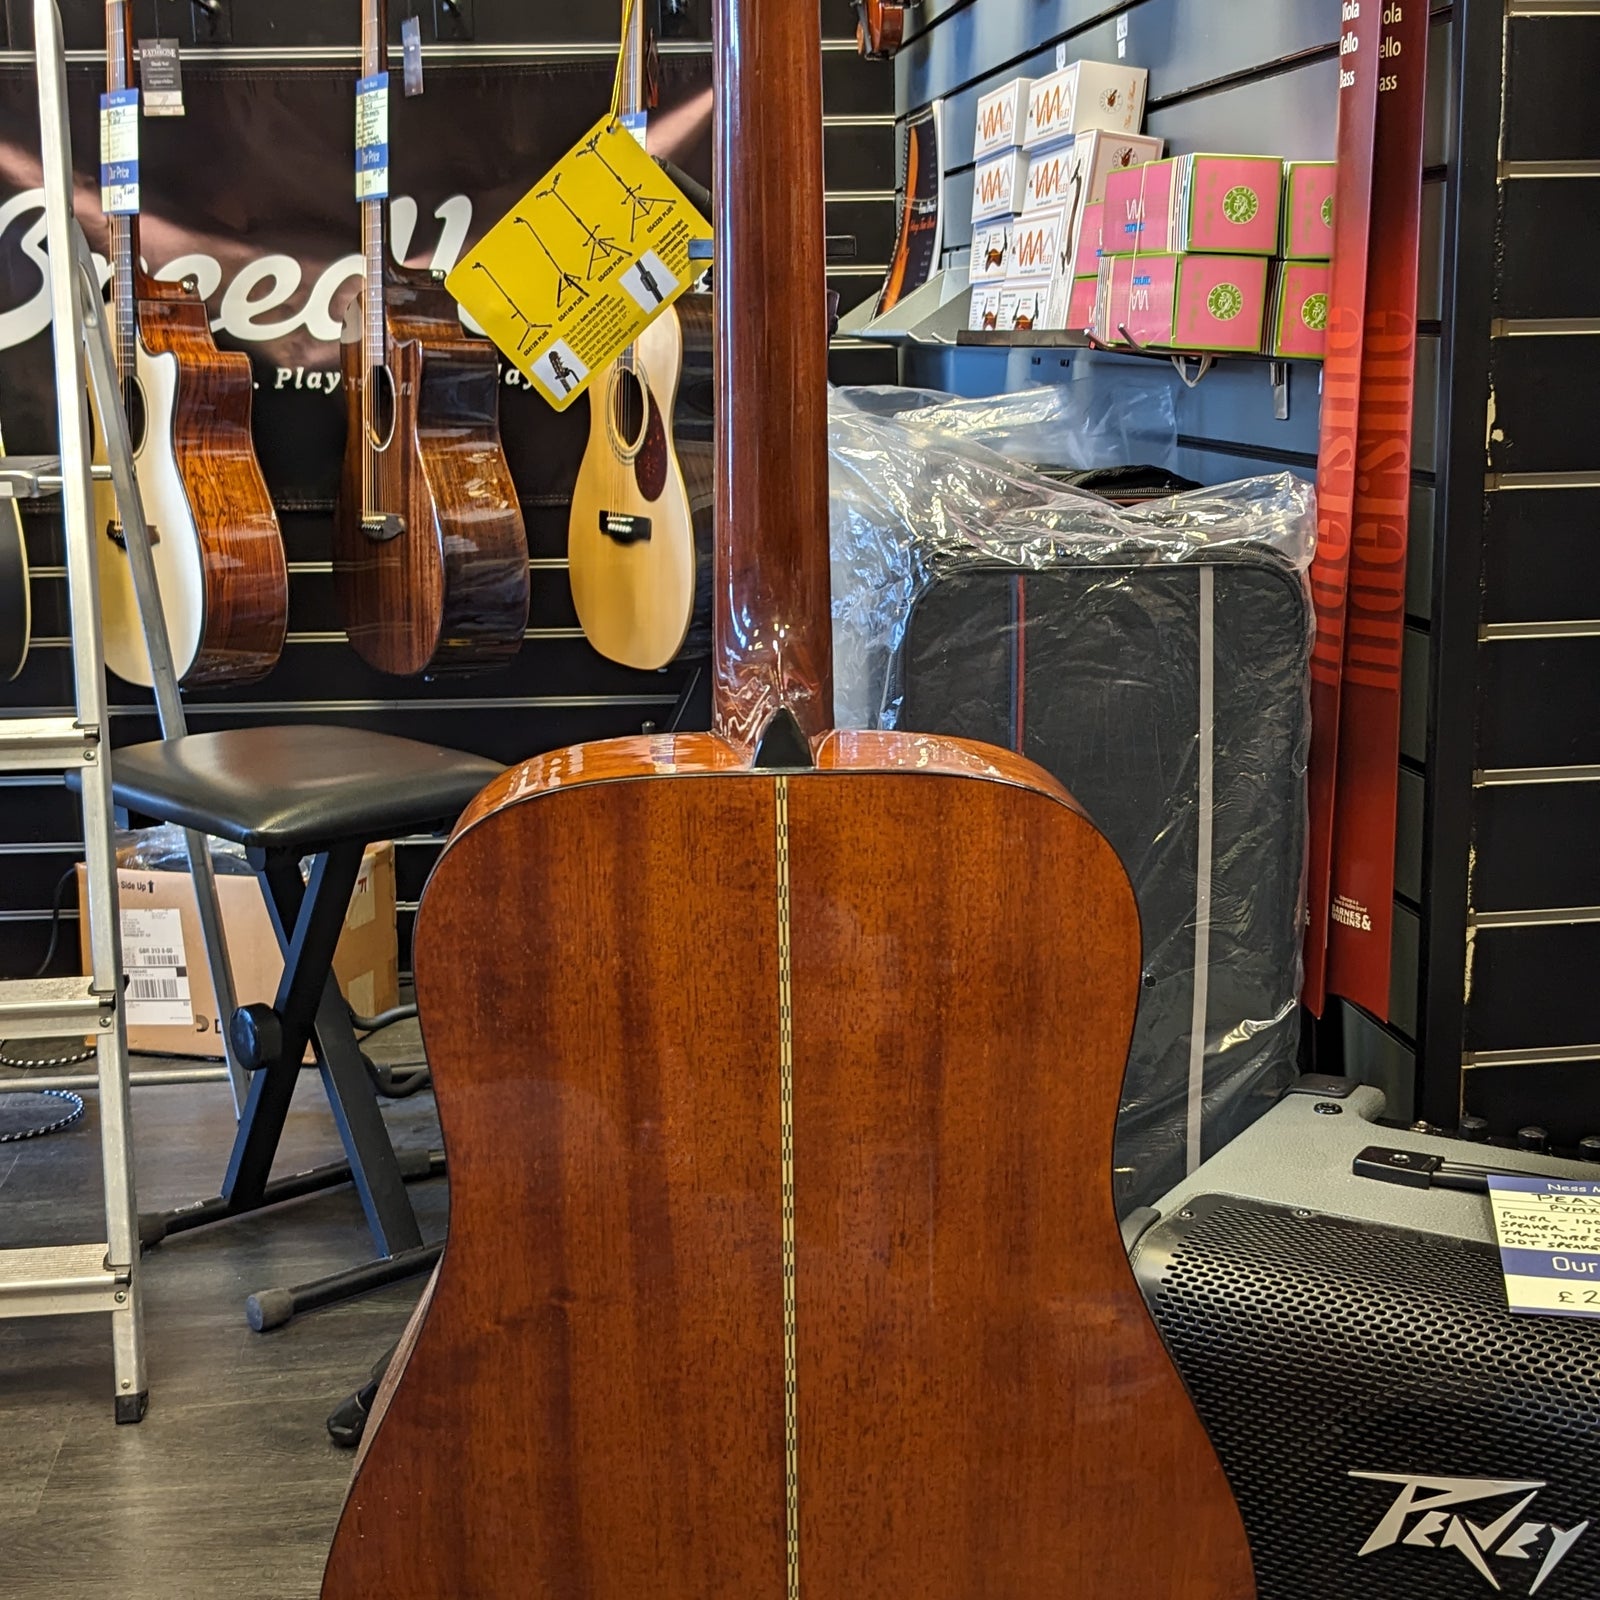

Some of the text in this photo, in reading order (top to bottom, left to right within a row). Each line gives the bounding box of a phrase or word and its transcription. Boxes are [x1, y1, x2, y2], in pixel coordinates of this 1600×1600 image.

[1380, 36, 1401, 58] ello
[1380, 75, 1397, 91] ass
[274, 366, 341, 394] Play
[121, 881, 146, 892] Side Up
[1547, 1183, 1587, 1193] Ness
[1552, 1256, 1598, 1273] Our
[1348, 1471, 1589, 1596] PEAVEY
